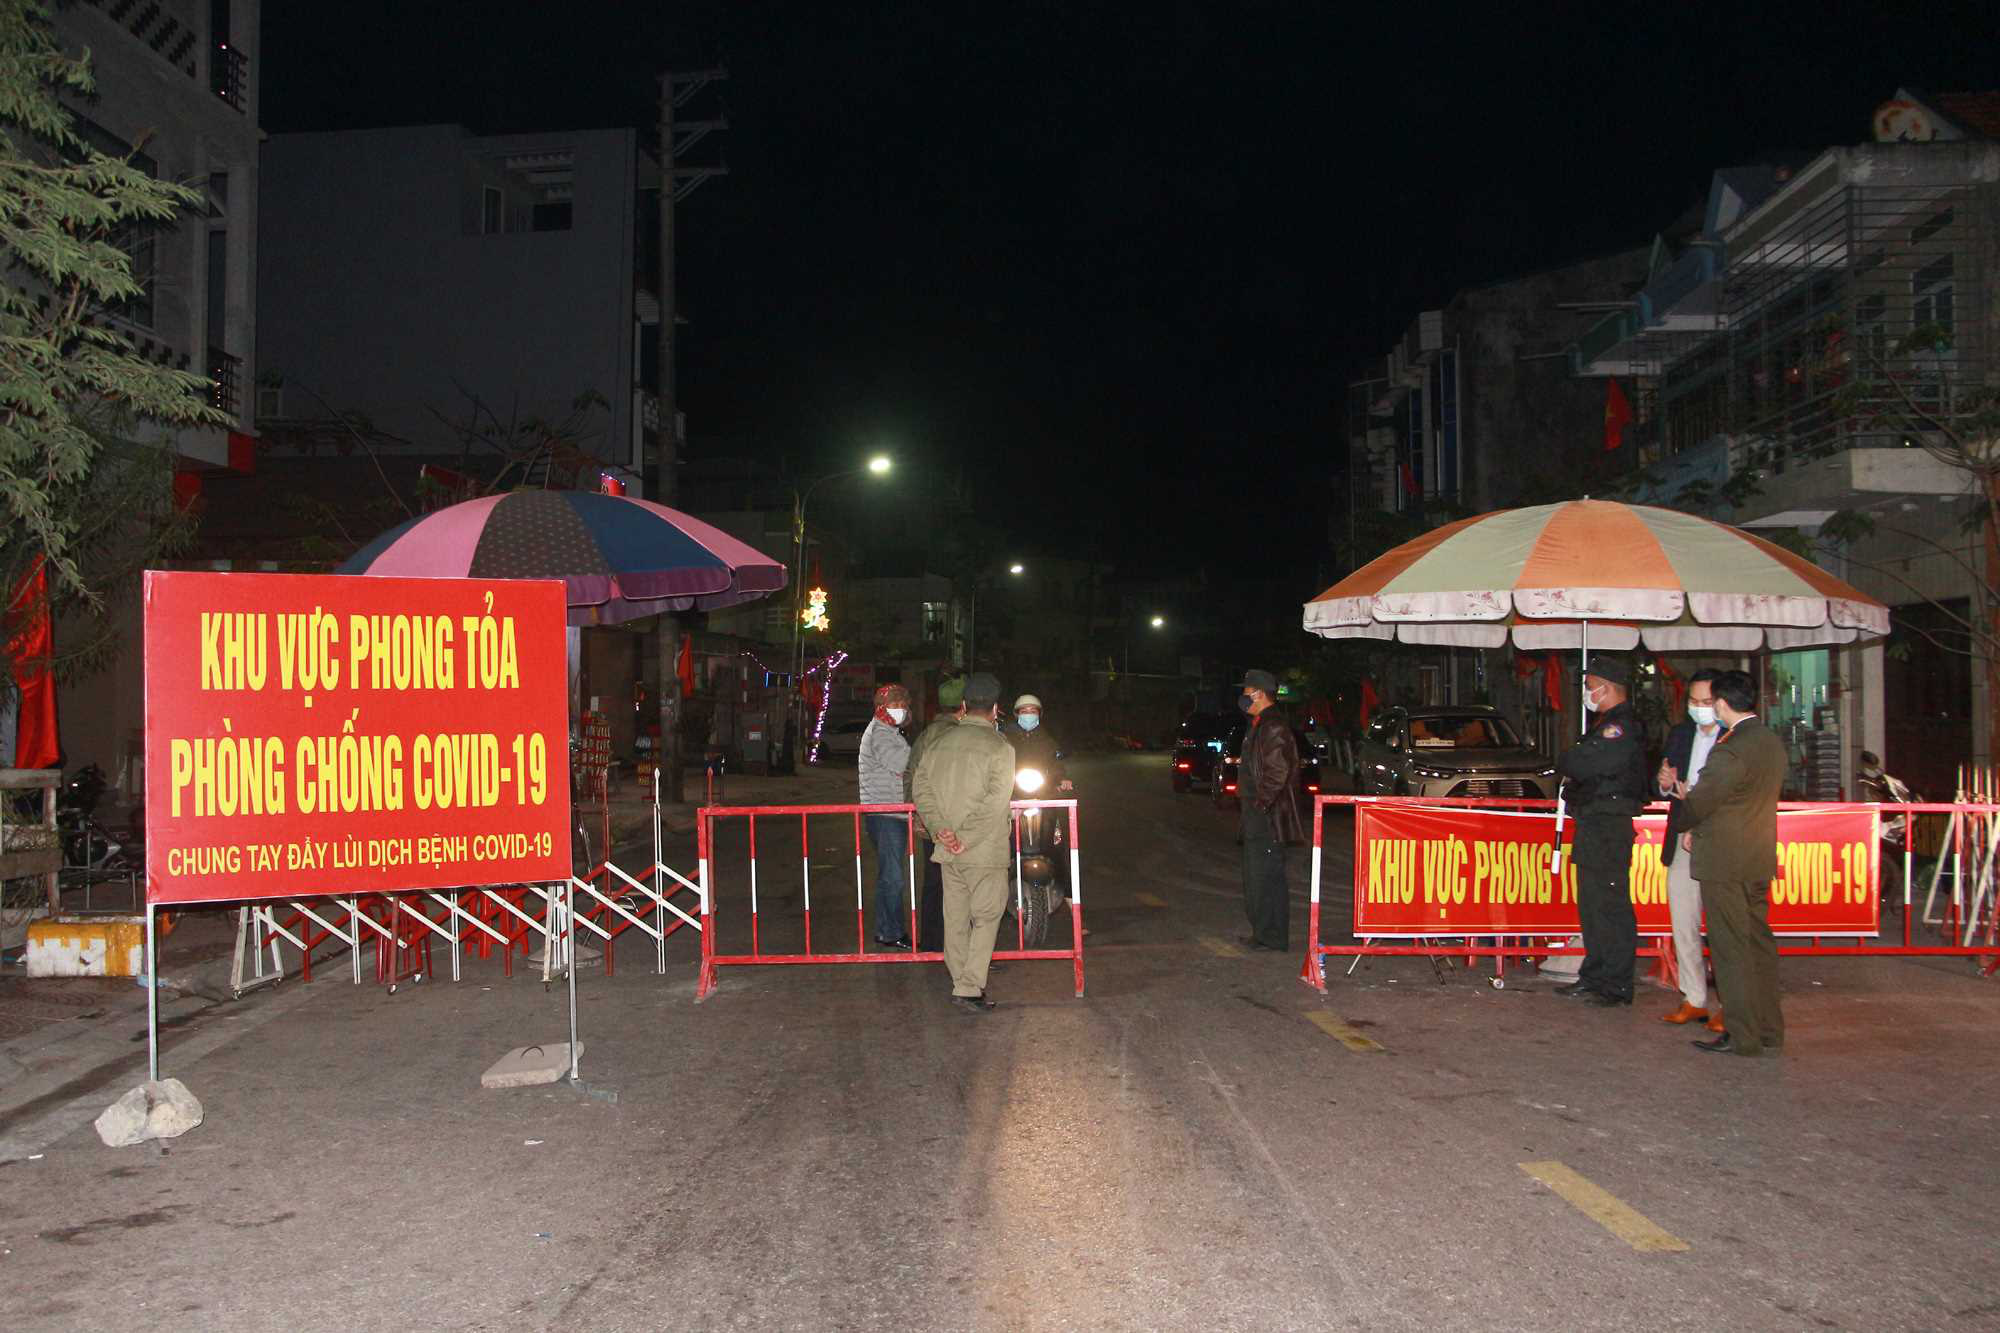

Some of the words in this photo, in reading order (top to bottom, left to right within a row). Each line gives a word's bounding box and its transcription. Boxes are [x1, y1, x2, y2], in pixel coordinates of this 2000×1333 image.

[201, 611, 267, 691] KHU
[277, 607, 340, 708] VỰC
[350, 614, 454, 690] PHONG
[462, 591, 520, 690] TỎA
[170, 718, 285, 817] PHÒNG
[296, 708, 404, 814] CHỐNG
[413, 732, 547, 810] COVID-19
[167, 846, 241, 876] CHUNG
[246, 844, 282, 871] TAY
[287, 836, 328, 871] ĐẨY
[333, 834, 363, 868] LÙI
[368, 838, 413, 873] DỊCH
[418, 832, 468, 870] BỆNH
[472, 831, 553, 862] COVID-19
[1368, 838, 1417, 905] KHU
[1422, 833, 1468, 919] VỰC
[1473, 841, 1552, 905] PHONG
